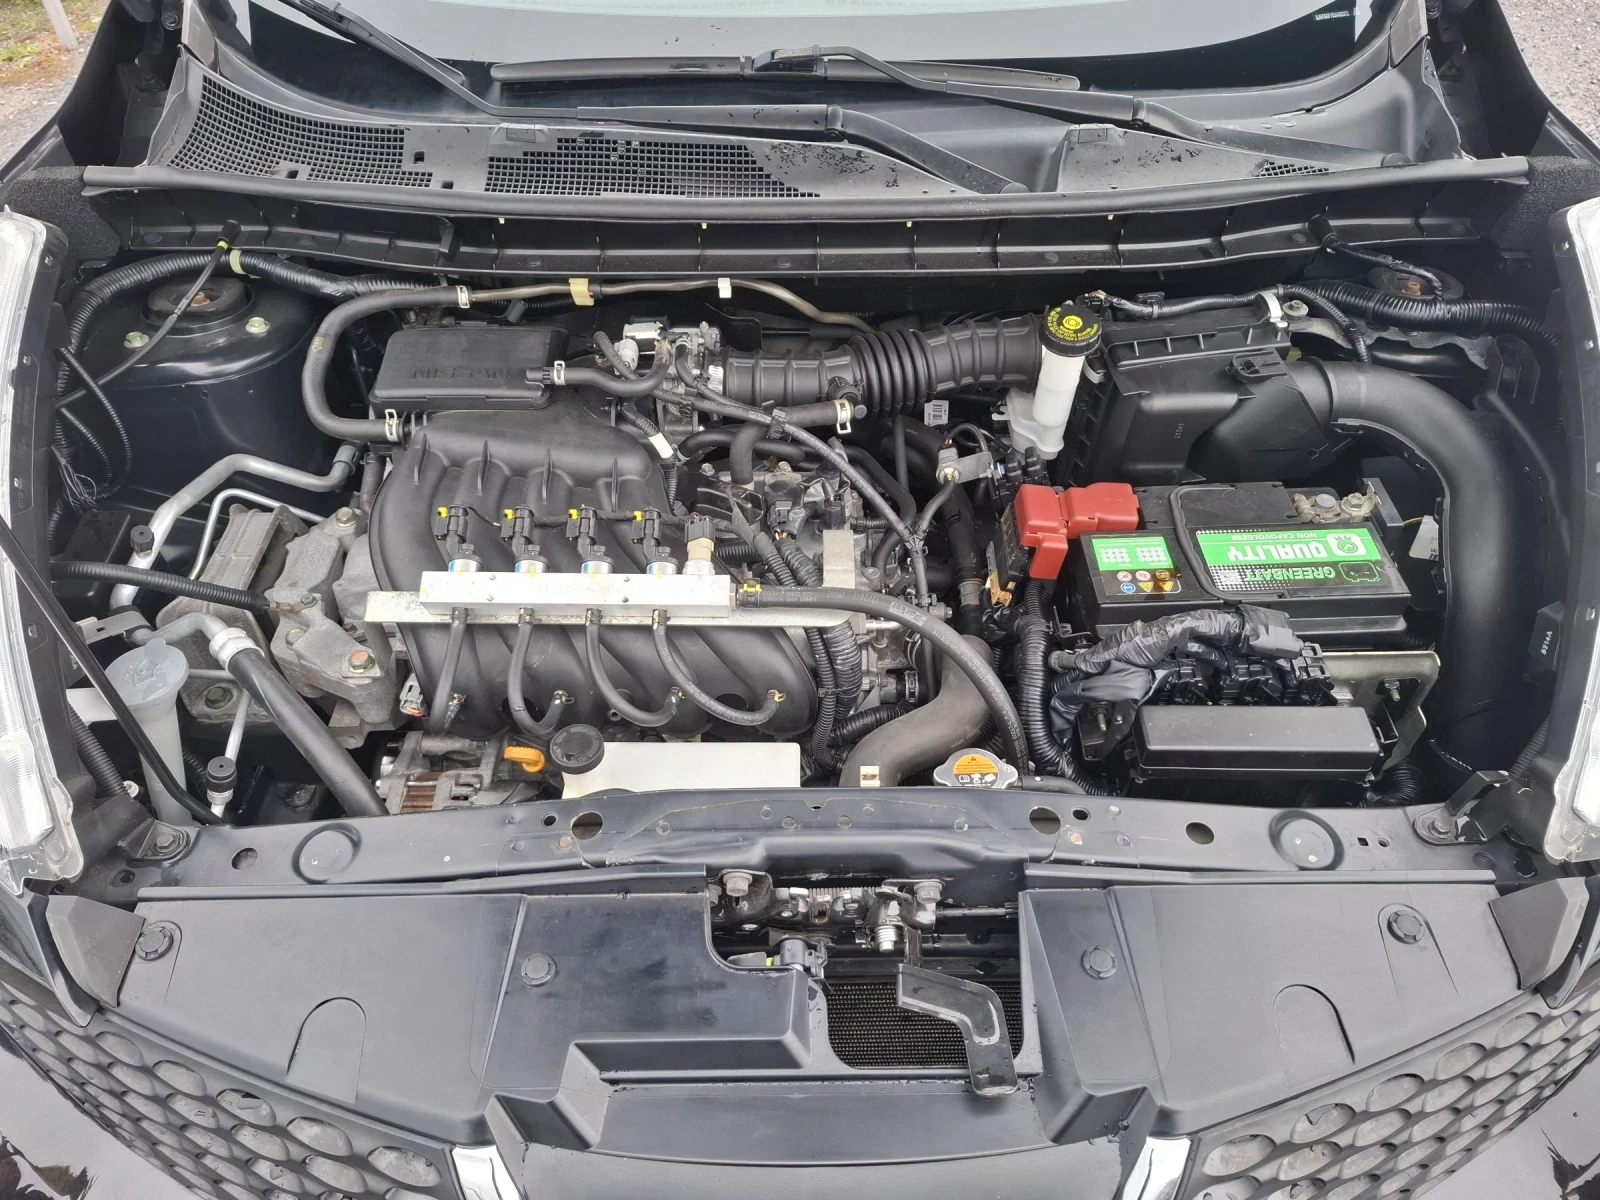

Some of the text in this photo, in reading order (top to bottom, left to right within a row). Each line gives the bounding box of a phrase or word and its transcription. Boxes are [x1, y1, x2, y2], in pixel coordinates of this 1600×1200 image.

[412, 367, 510, 379] NISSAN
[1231, 531, 1317, 541] NON CAPOVOLGERE
[1227, 542, 1328, 561] QUALITY
[1244, 566, 1336, 583] GREENBATT
[890, 602, 925, 624] Parker
